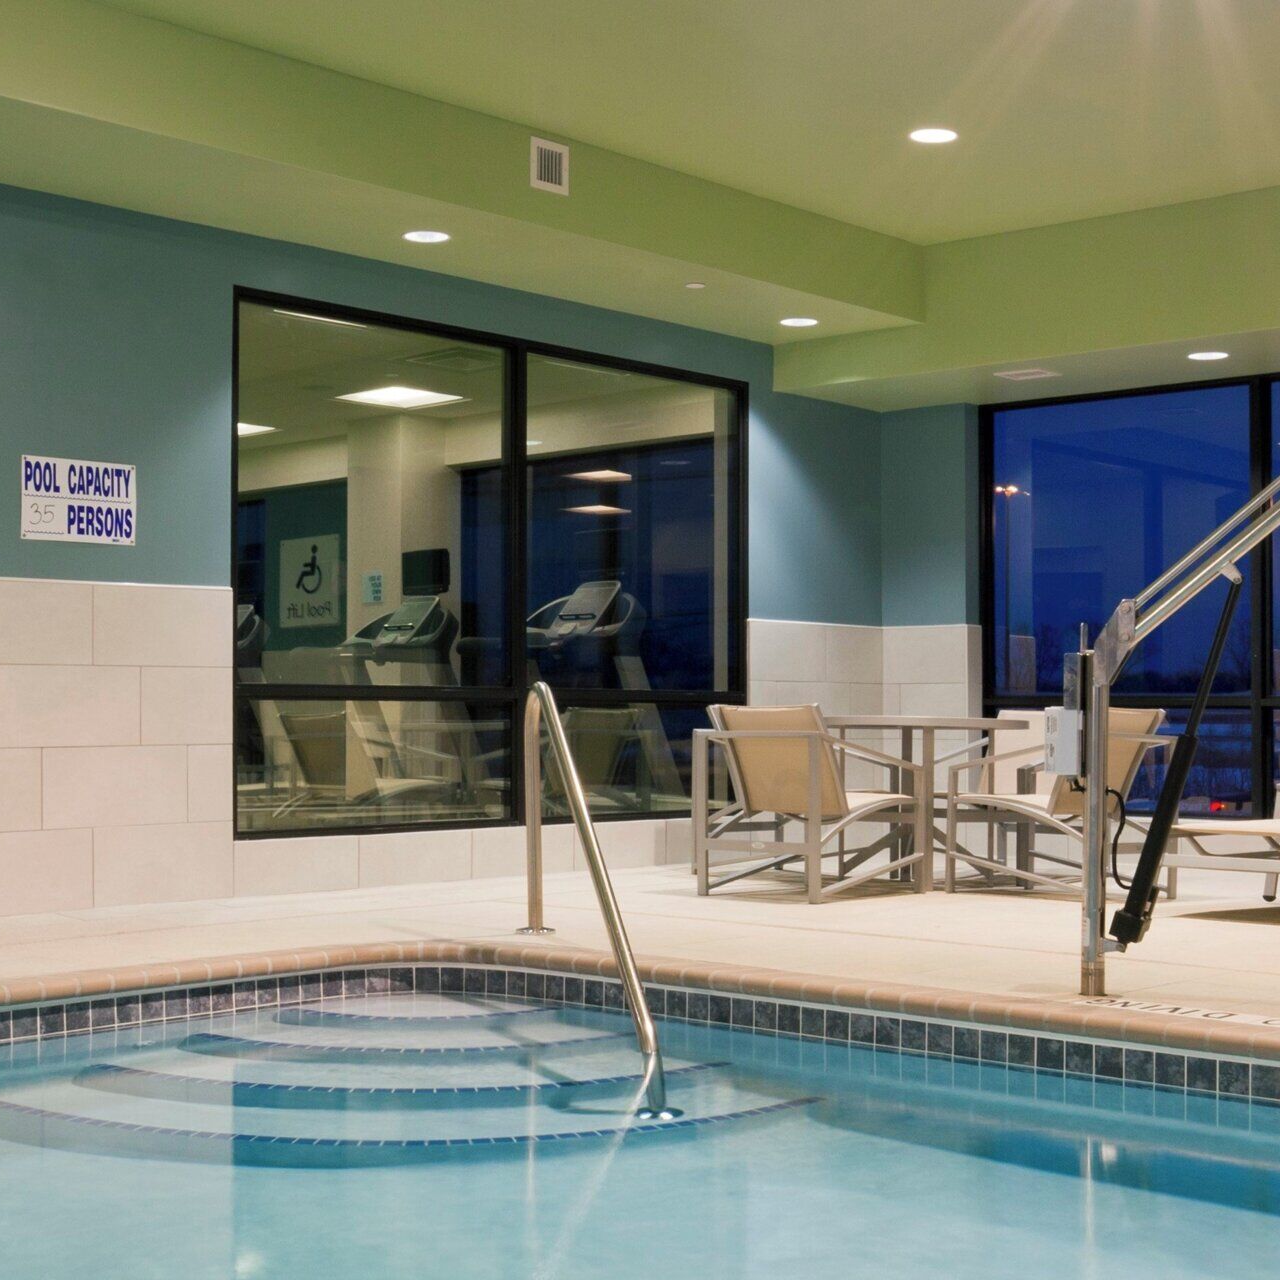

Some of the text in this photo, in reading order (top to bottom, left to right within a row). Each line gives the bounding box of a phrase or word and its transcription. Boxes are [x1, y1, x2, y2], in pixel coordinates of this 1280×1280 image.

[24, 460, 131, 498] POOL CAPACITY
[29, 502, 55, 525] 35
[67, 504, 133, 539] PERSONS
[1086, 998, 1235, 1019] DIVING
